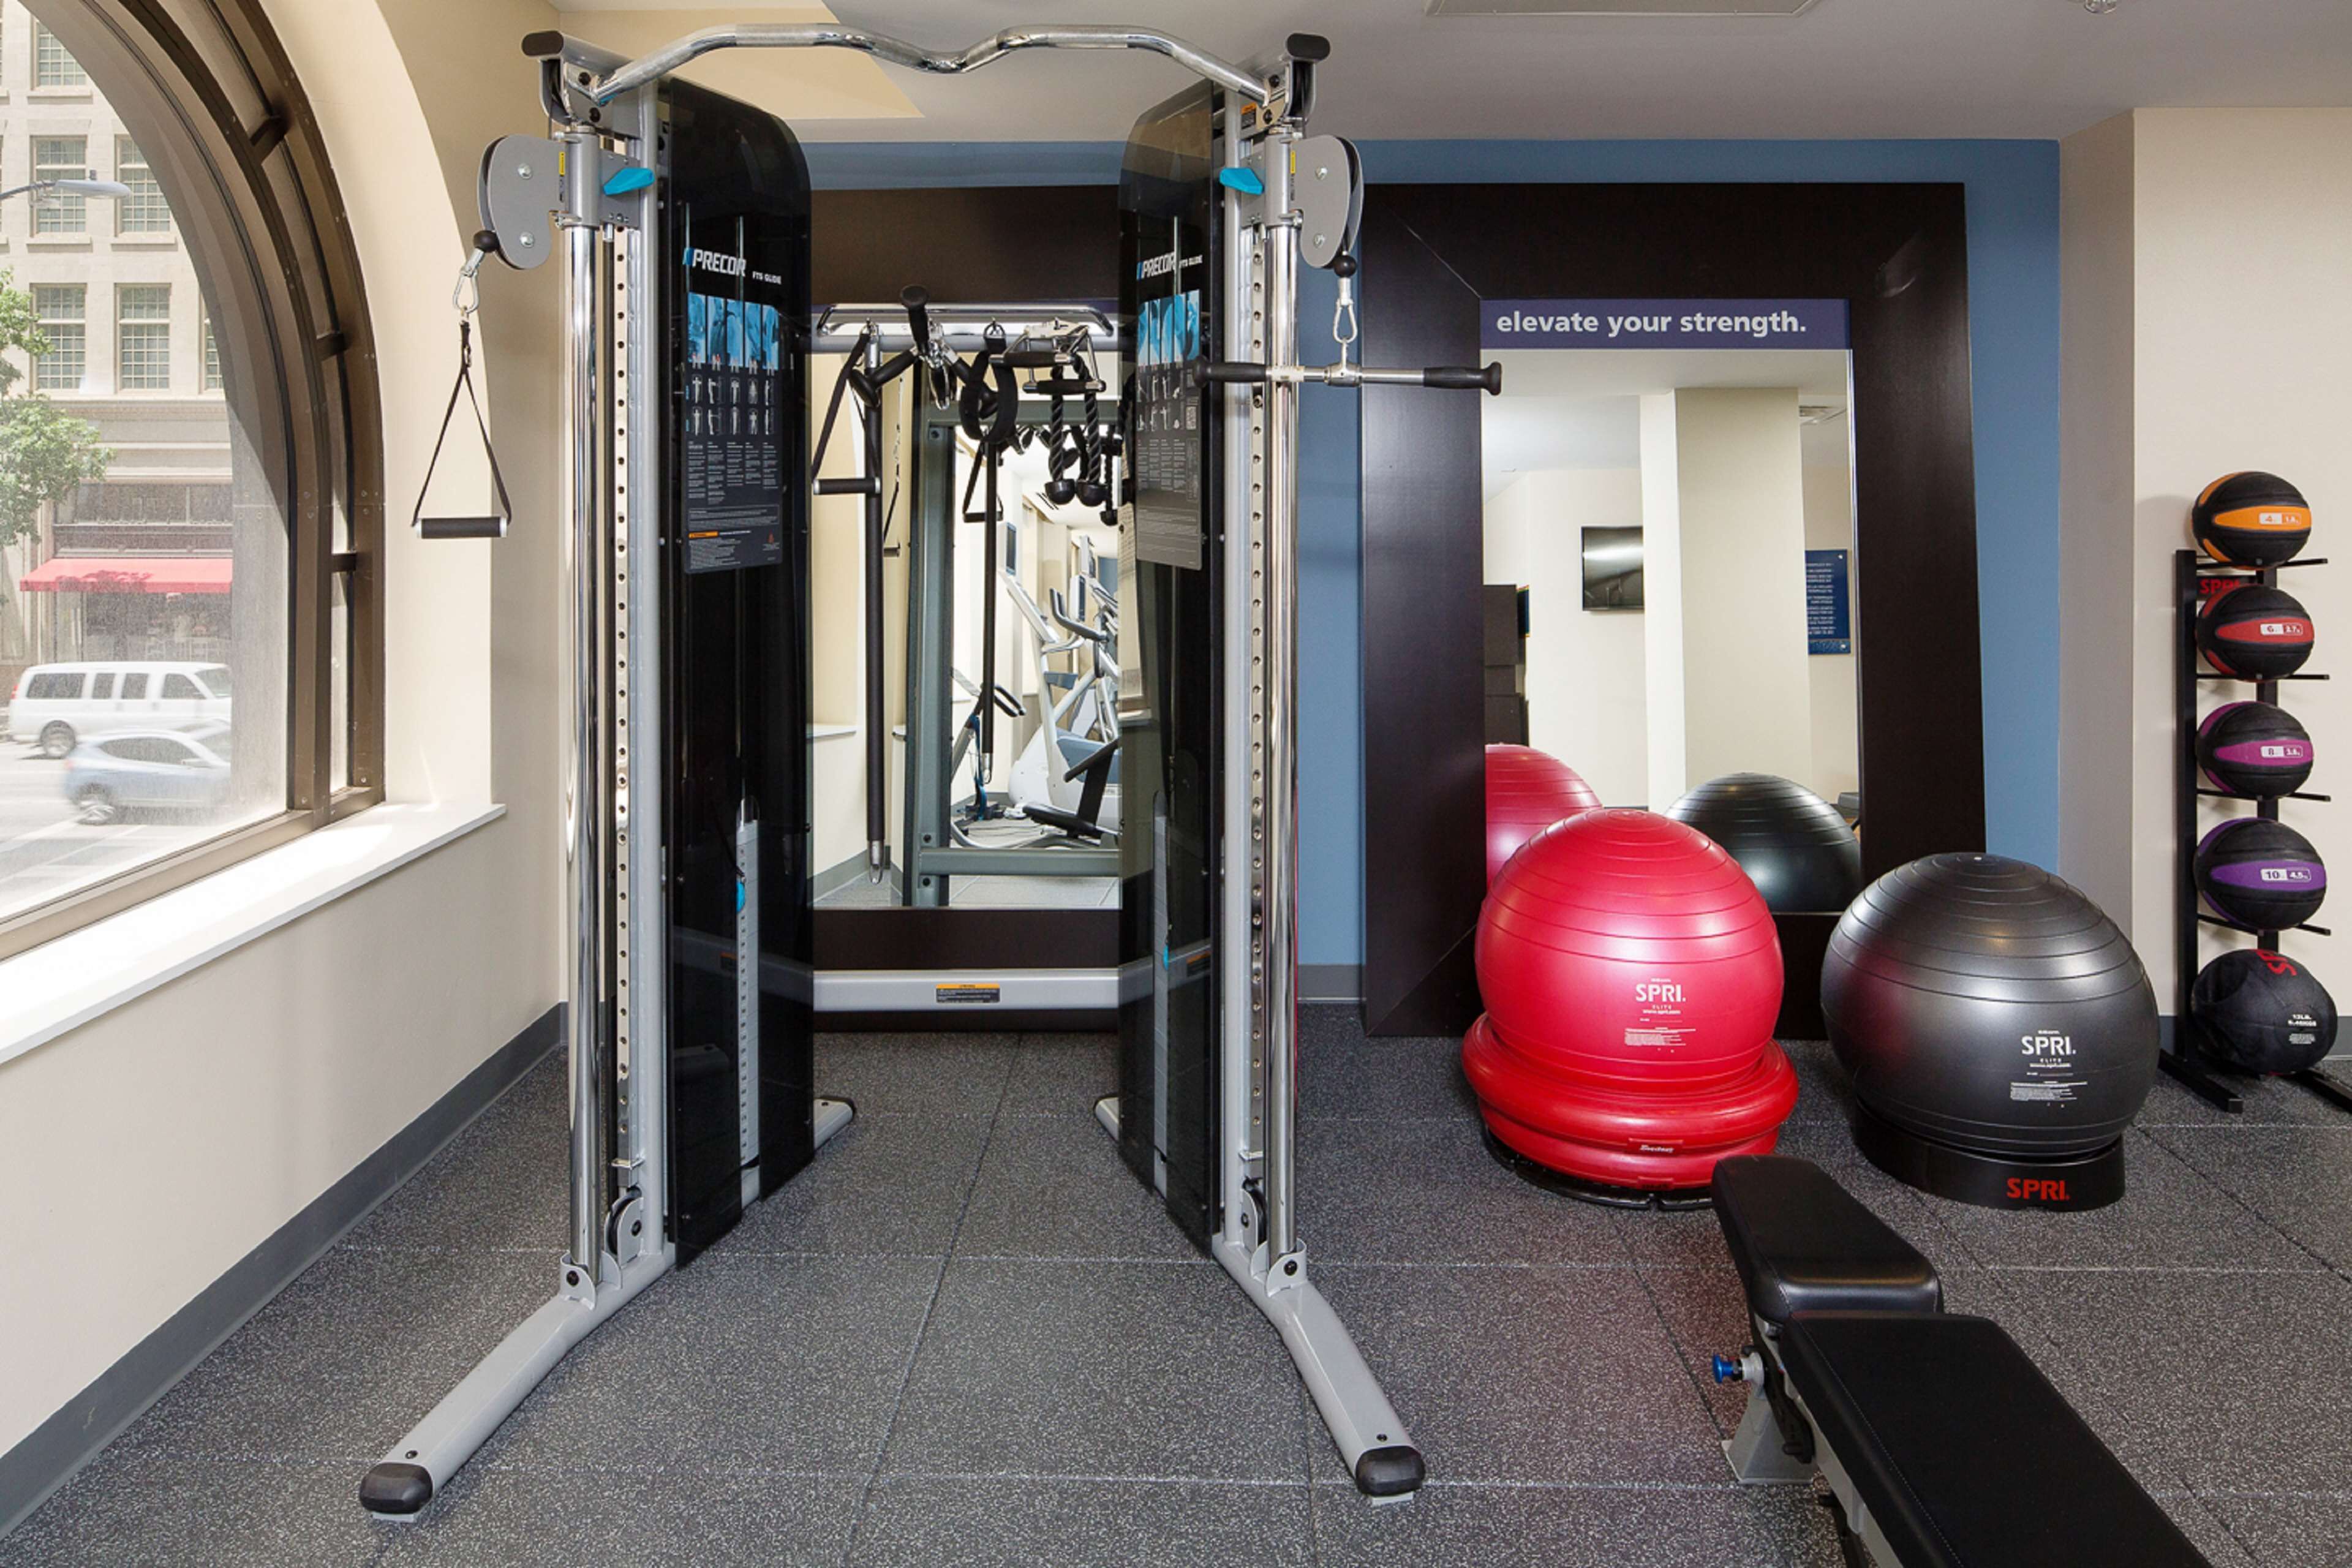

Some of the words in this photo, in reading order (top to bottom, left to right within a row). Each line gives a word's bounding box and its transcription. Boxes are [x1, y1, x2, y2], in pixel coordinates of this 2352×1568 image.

[692, 247, 747, 277] PRECOR
[1141, 251, 1177, 279] PRECOR
[1496, 311, 1599, 333] elevate
[1607, 315, 1672, 337] your
[1680, 311, 1807, 337] strength.
[2264, 870, 2280, 879] 10
[1636, 982, 1686, 1003] SPRI.
[2021, 1035, 2077, 1055] SPRI.
